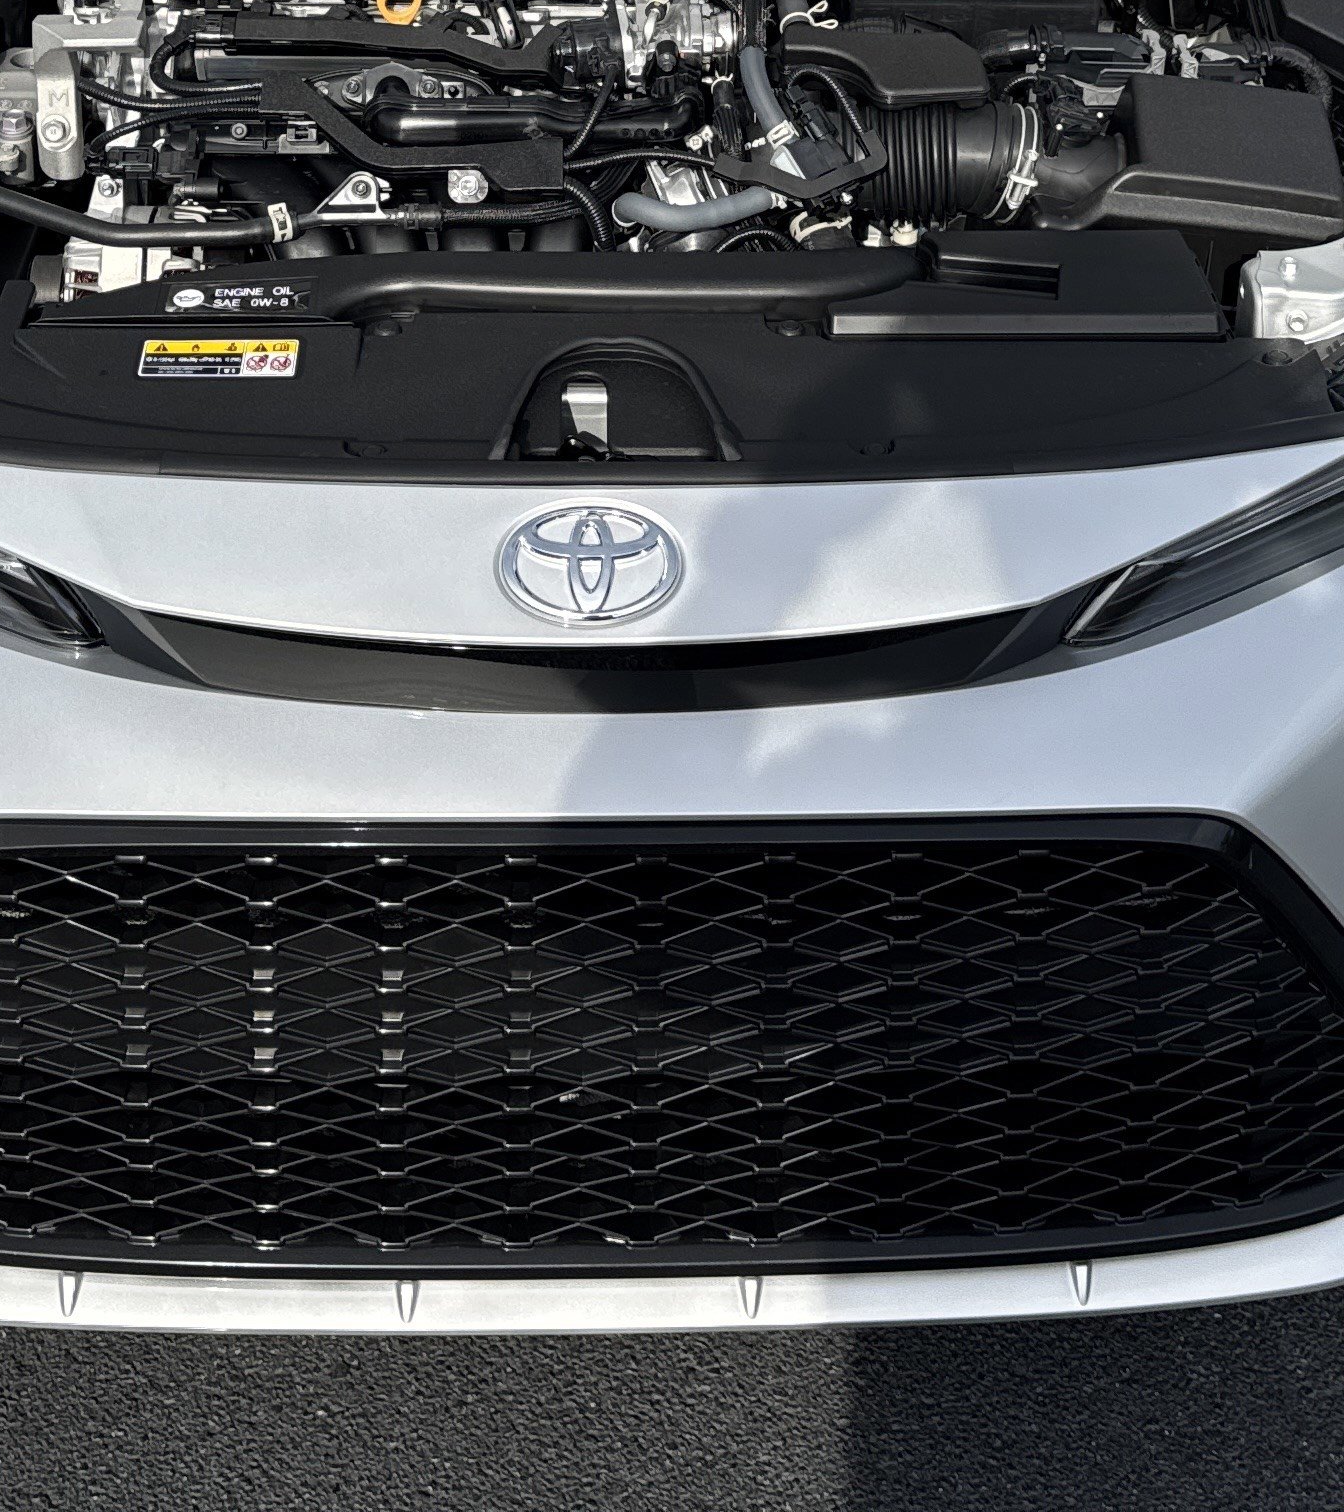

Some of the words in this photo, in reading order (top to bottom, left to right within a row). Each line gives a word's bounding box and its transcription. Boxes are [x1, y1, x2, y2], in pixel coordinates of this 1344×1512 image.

[215, 287, 264, 297] ENGINE
[272, 286, 294, 296] OIL
[213, 298, 241, 308] SAE
[250, 297, 289, 307] 0W-8
